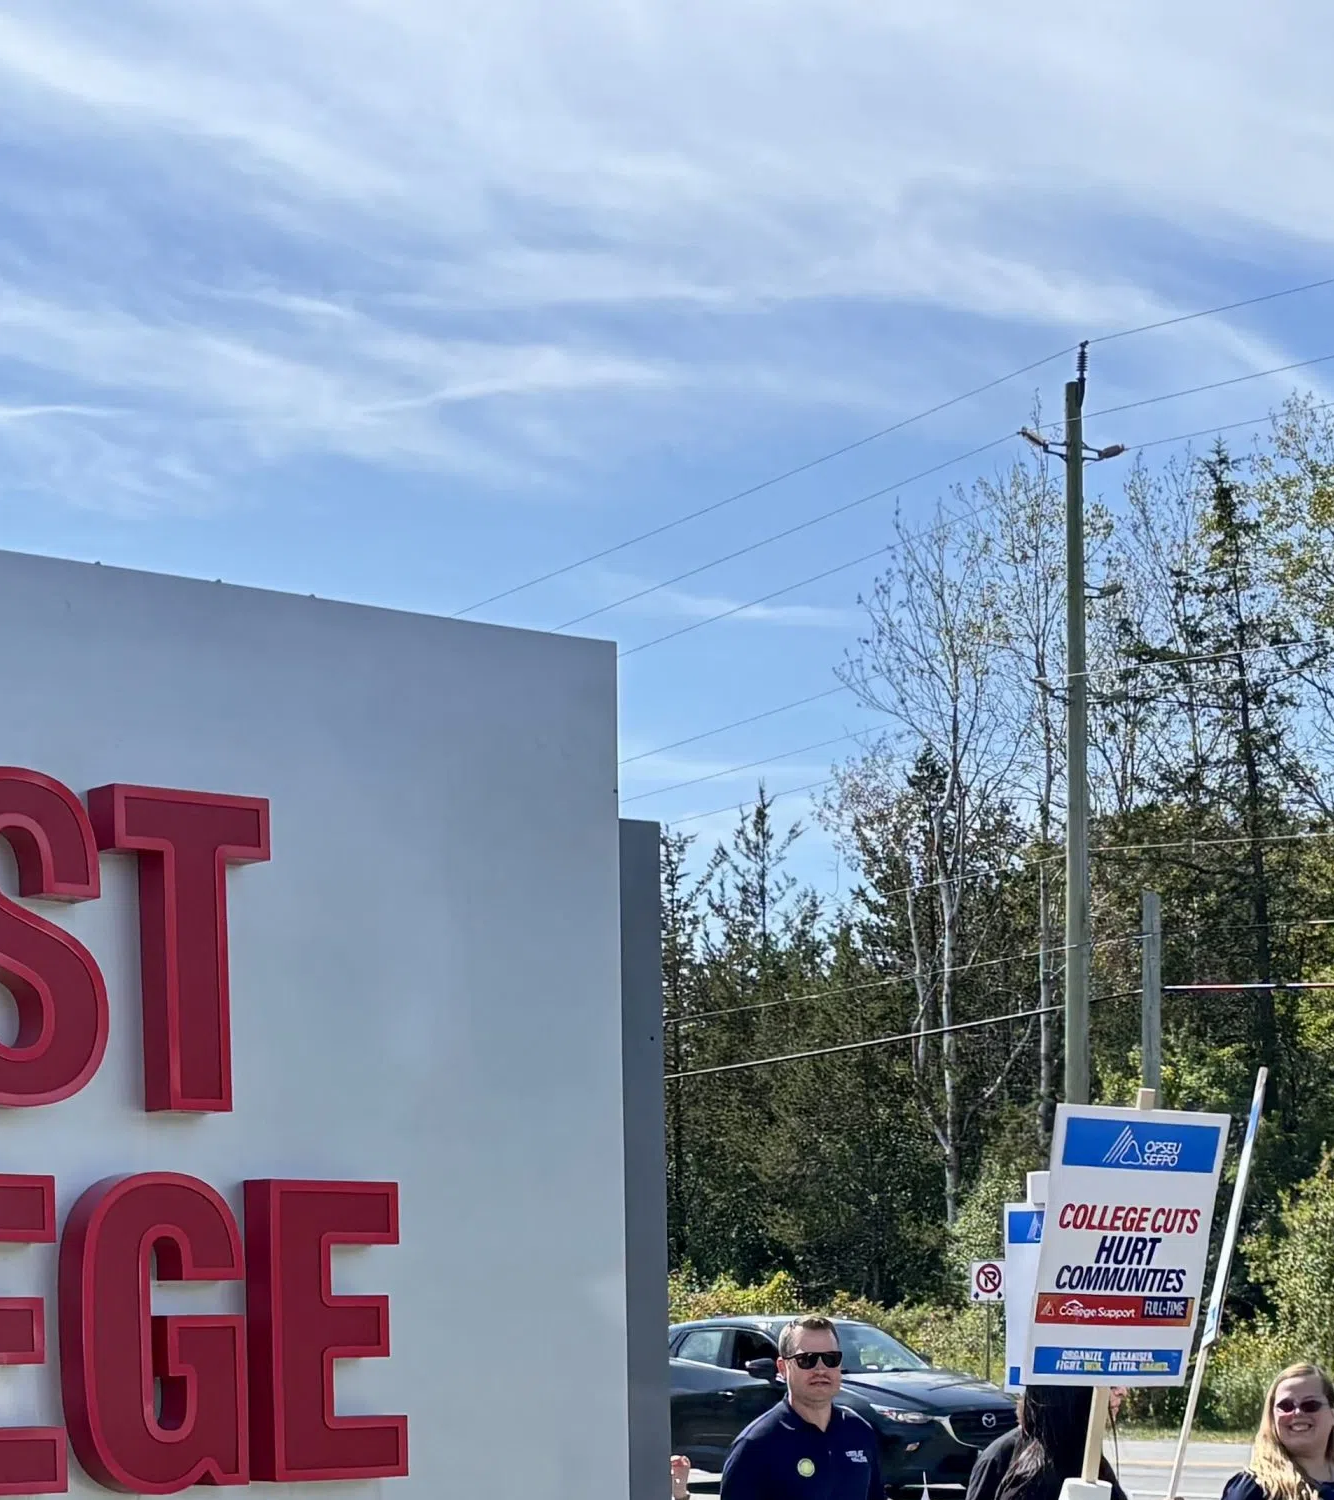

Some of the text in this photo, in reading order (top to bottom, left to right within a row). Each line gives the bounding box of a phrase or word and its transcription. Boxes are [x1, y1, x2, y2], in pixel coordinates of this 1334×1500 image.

[1144, 1140, 1183, 1155] OPSEU
[1142, 1153, 1179, 1167] SEFPO
[1058, 1203, 1201, 1235] COLLEGE CUTS
[1094, 1235, 1162, 1266] HURT
[1055, 1265, 1187, 1294] COMMUNITIES
[1097, 1306, 1136, 1319] Support
[1143, 1300, 1185, 1316] FULL-TIME
